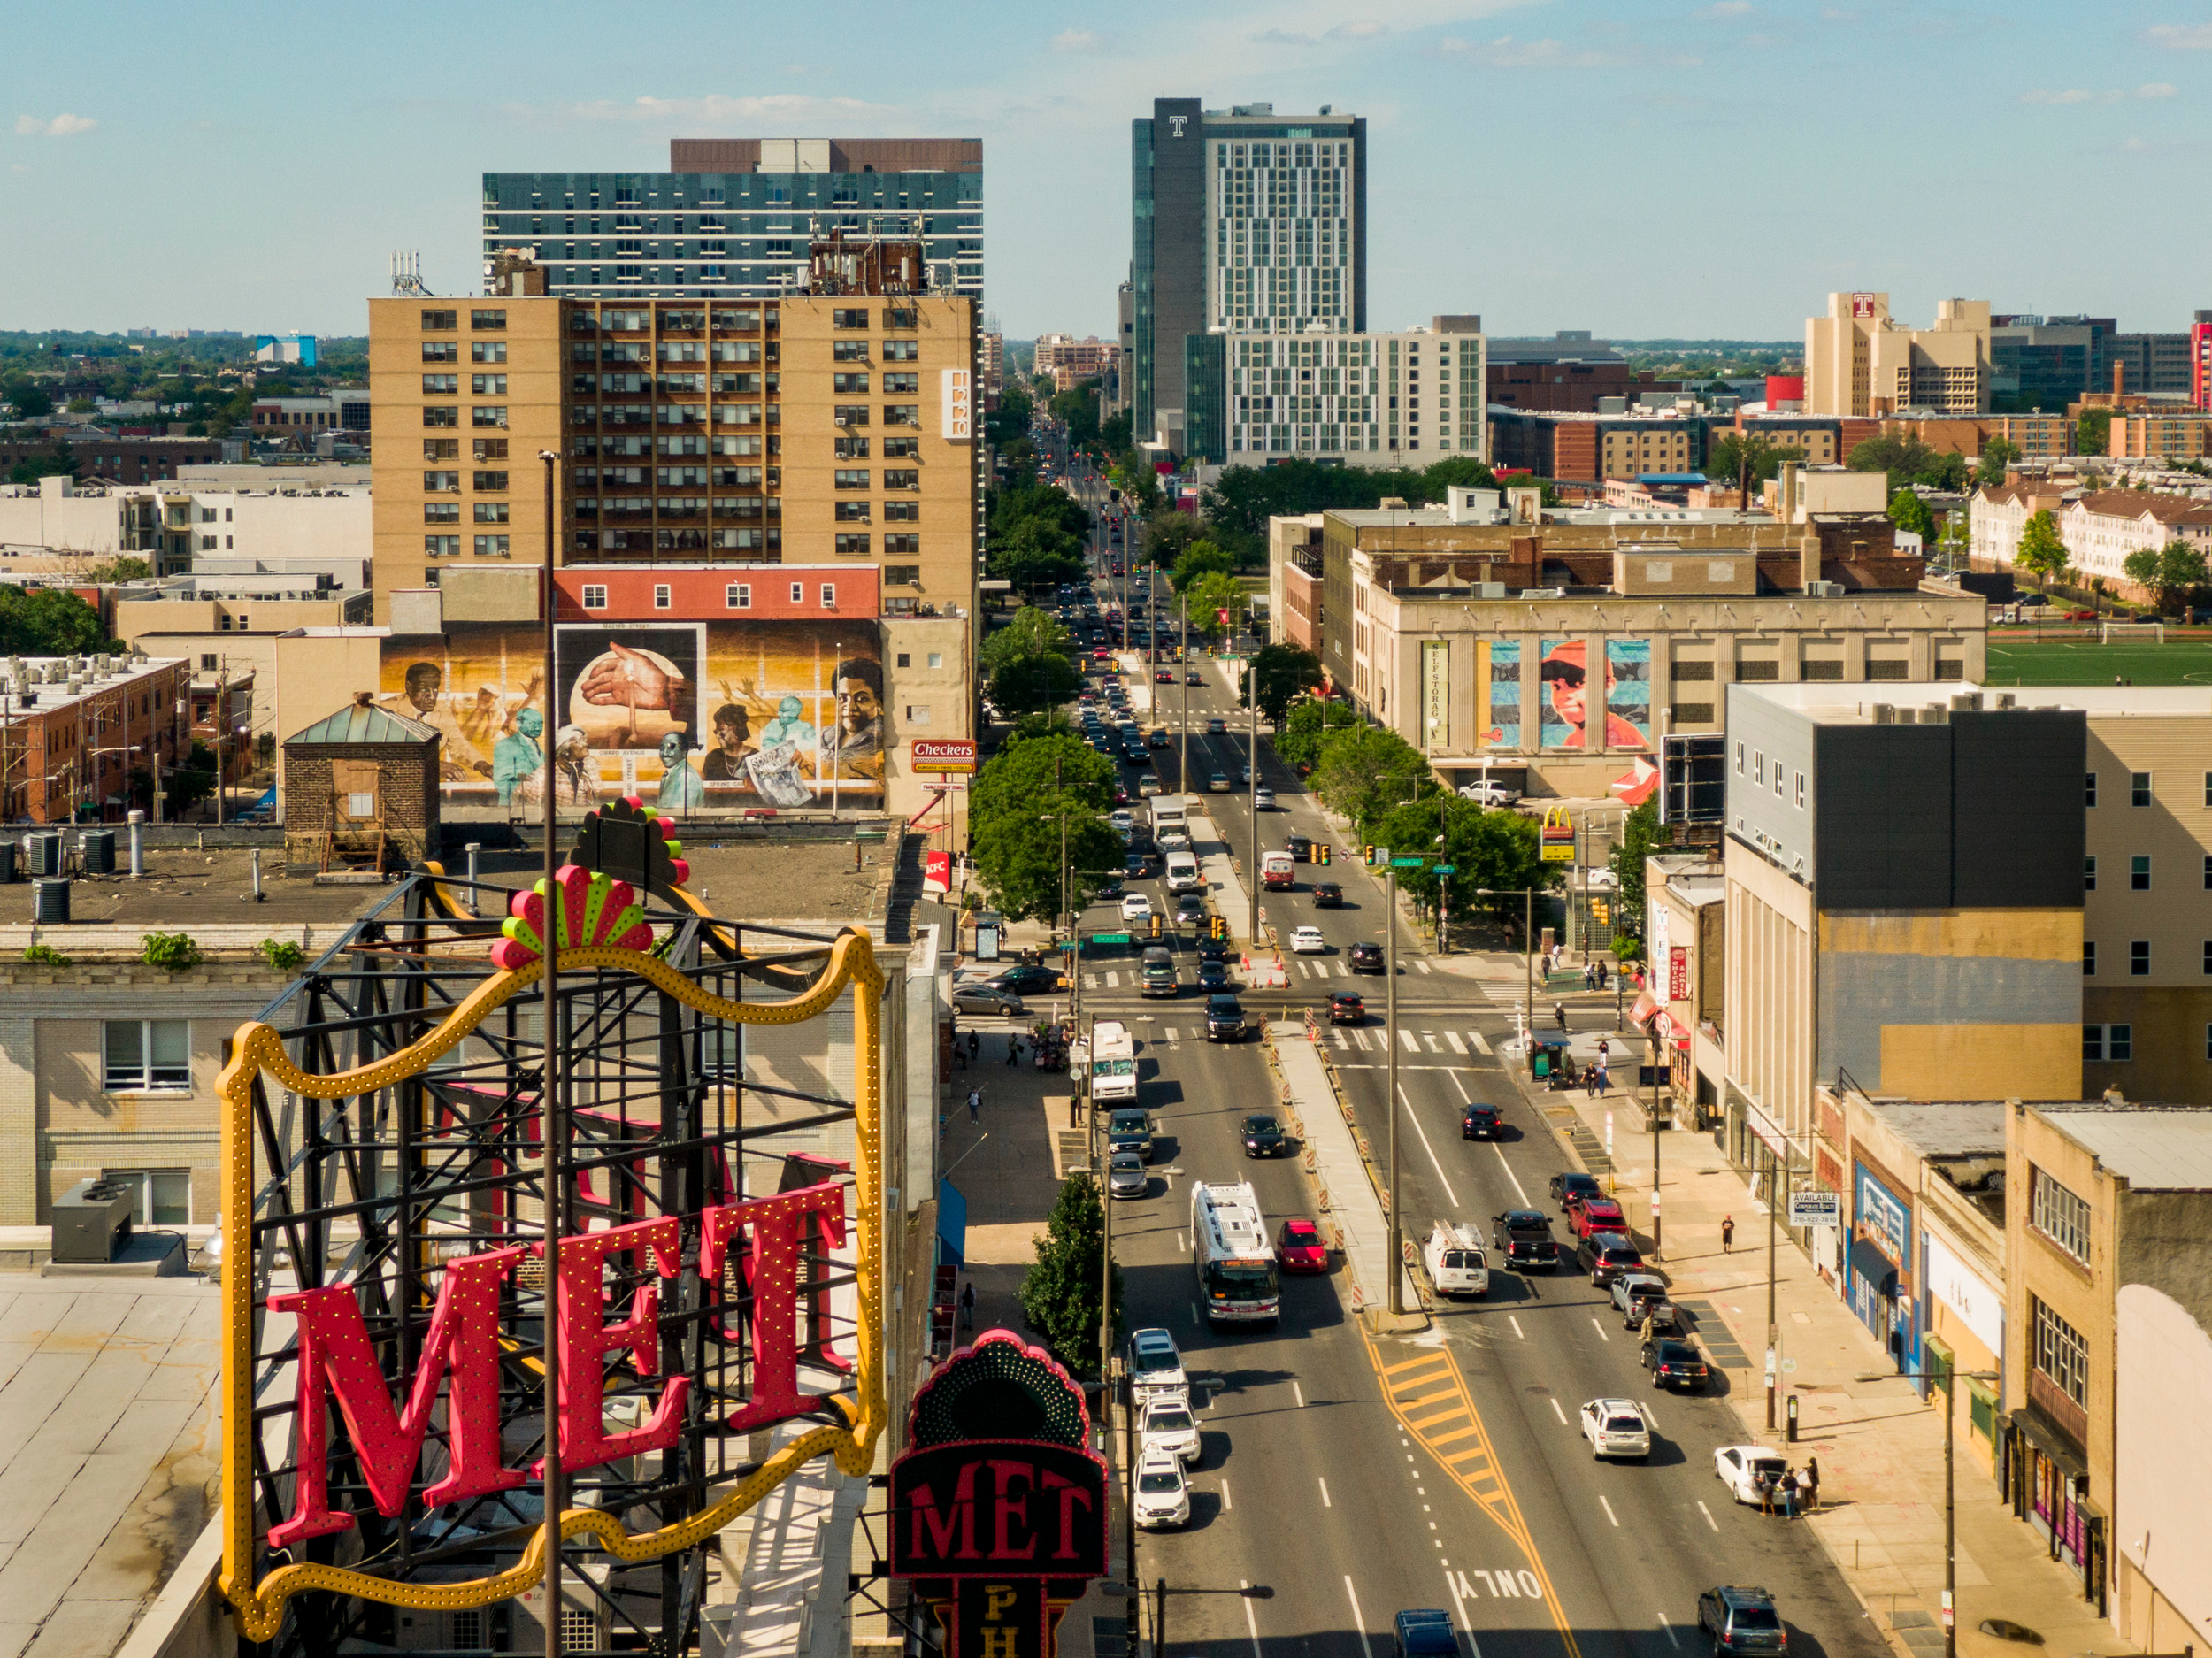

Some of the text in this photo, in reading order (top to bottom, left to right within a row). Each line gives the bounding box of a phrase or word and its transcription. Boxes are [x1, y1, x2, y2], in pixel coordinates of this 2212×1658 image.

[1169, 116, 1187, 137] T
[1853, 294, 1874, 317] T
[915, 743, 973, 756] Checkers
[926, 861, 946, 875] KFC
[266, 1182, 848, 1547] MET
[905, 1460, 1093, 1561] MET
[1456, 1570, 1543, 1599] ONLY
